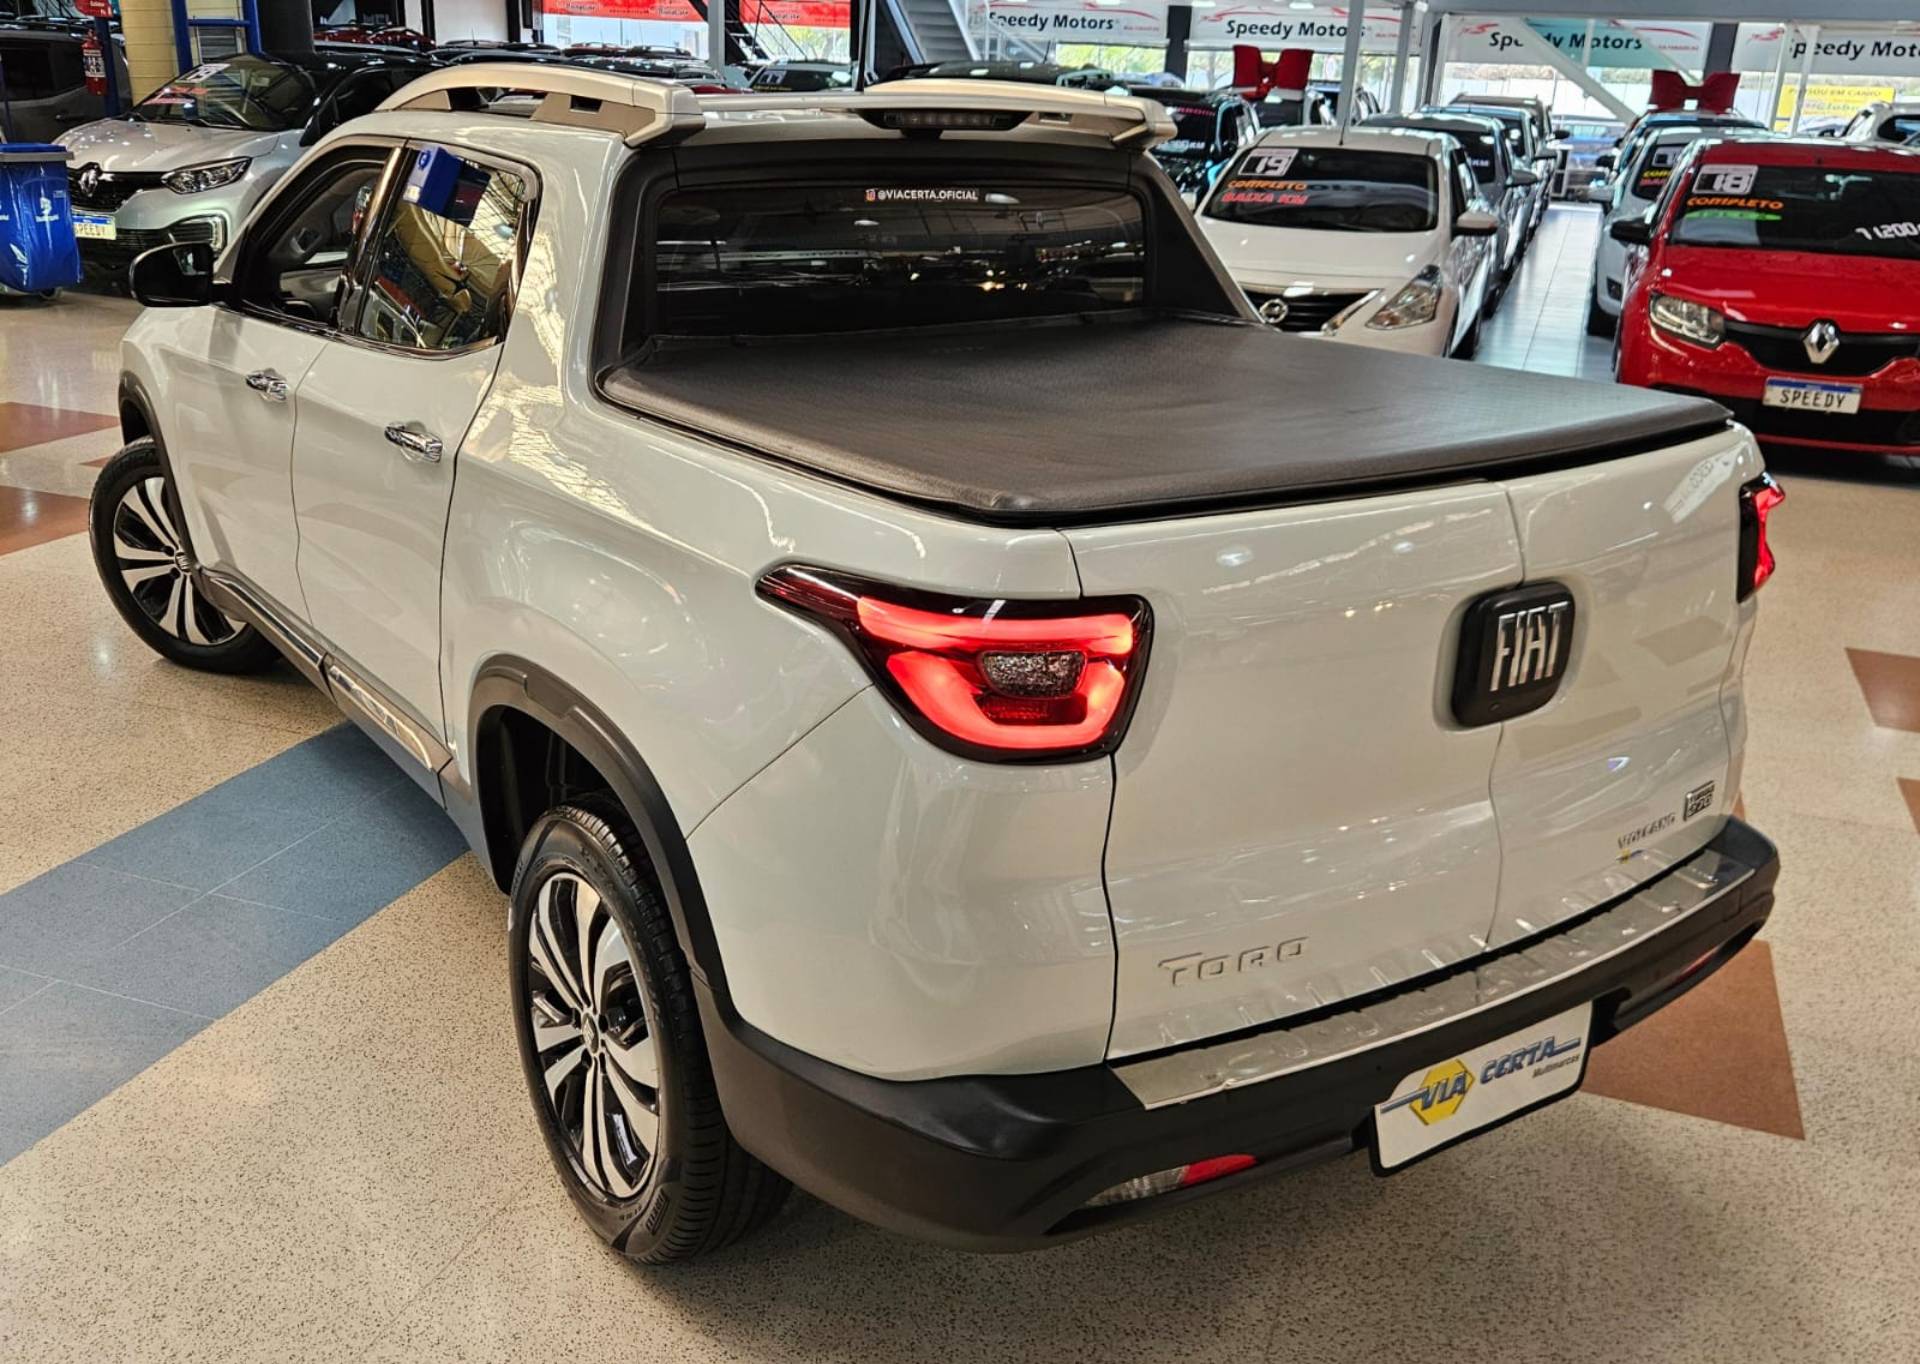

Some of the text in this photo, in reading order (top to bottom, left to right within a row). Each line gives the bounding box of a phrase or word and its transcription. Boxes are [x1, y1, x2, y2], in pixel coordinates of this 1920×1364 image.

[1053, 14, 1114, 30] Motors
[1226, 20, 1366, 40] Speedy Moto
[1569, 33, 1642, 49] Motors
[1789, 40, 1865, 61] peedy
[1255, 156, 1288, 175] 19
[1227, 180, 1308, 191] COMPLETO
[1712, 173, 1751, 192] 18
[1686, 197, 1785, 210] COMPLETO
[1779, 389, 1846, 408] SPEEDY
[1490, 601, 1569, 692] FIAT
[1157, 936, 1310, 986] TORO
[1414, 1036, 1564, 1111] VIA CERTA
